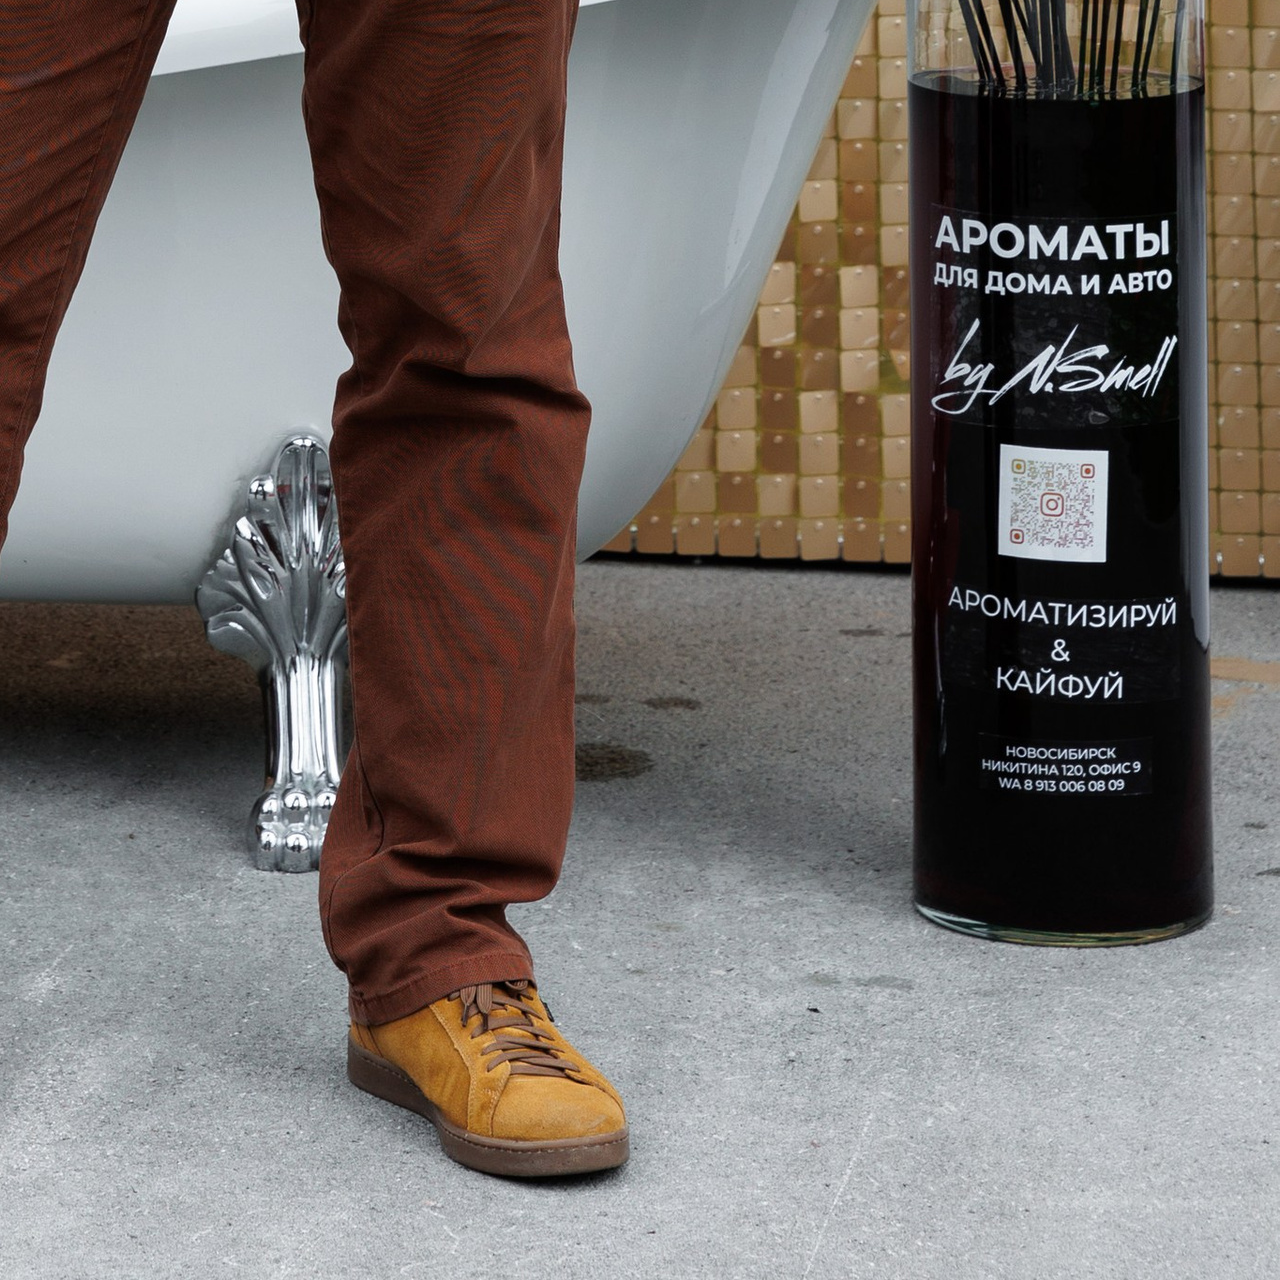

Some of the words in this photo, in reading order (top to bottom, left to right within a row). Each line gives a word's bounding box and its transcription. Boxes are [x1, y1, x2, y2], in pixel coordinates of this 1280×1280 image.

[934, 215, 1169, 261] АРОМАТЫ
[934, 262, 978, 288] ДЛЯ
[984, 270, 1073, 296] ДОМА
[1081, 274, 1100, 295] И
[1107, 268, 1173, 295] АВТО
[931, 317, 997, 415] by
[948, 586, 1177, 628] АРОМАТИЗИРУЙ
[1050, 638, 1070, 662] &
[996, 666, 1123, 699] КАЙФУЙ
[981, 759, 1059, 776] НИКИТИНА
[1061, 764, 1086, 778] 120,
[1088, 761, 1131, 776] ОФИС
[1132, 761, 1142, 774] 9
[1005, 746, 1116, 760] НОВОСИБИРСК
[998, 777, 1022, 790] WA
[1023, 778, 1033, 791] 8
[1035, 779, 1057, 792] 913
[1059, 780, 1086, 793] 006
[1087, 780, 1106, 792] 08
[1107, 779, 1125, 791] 09
